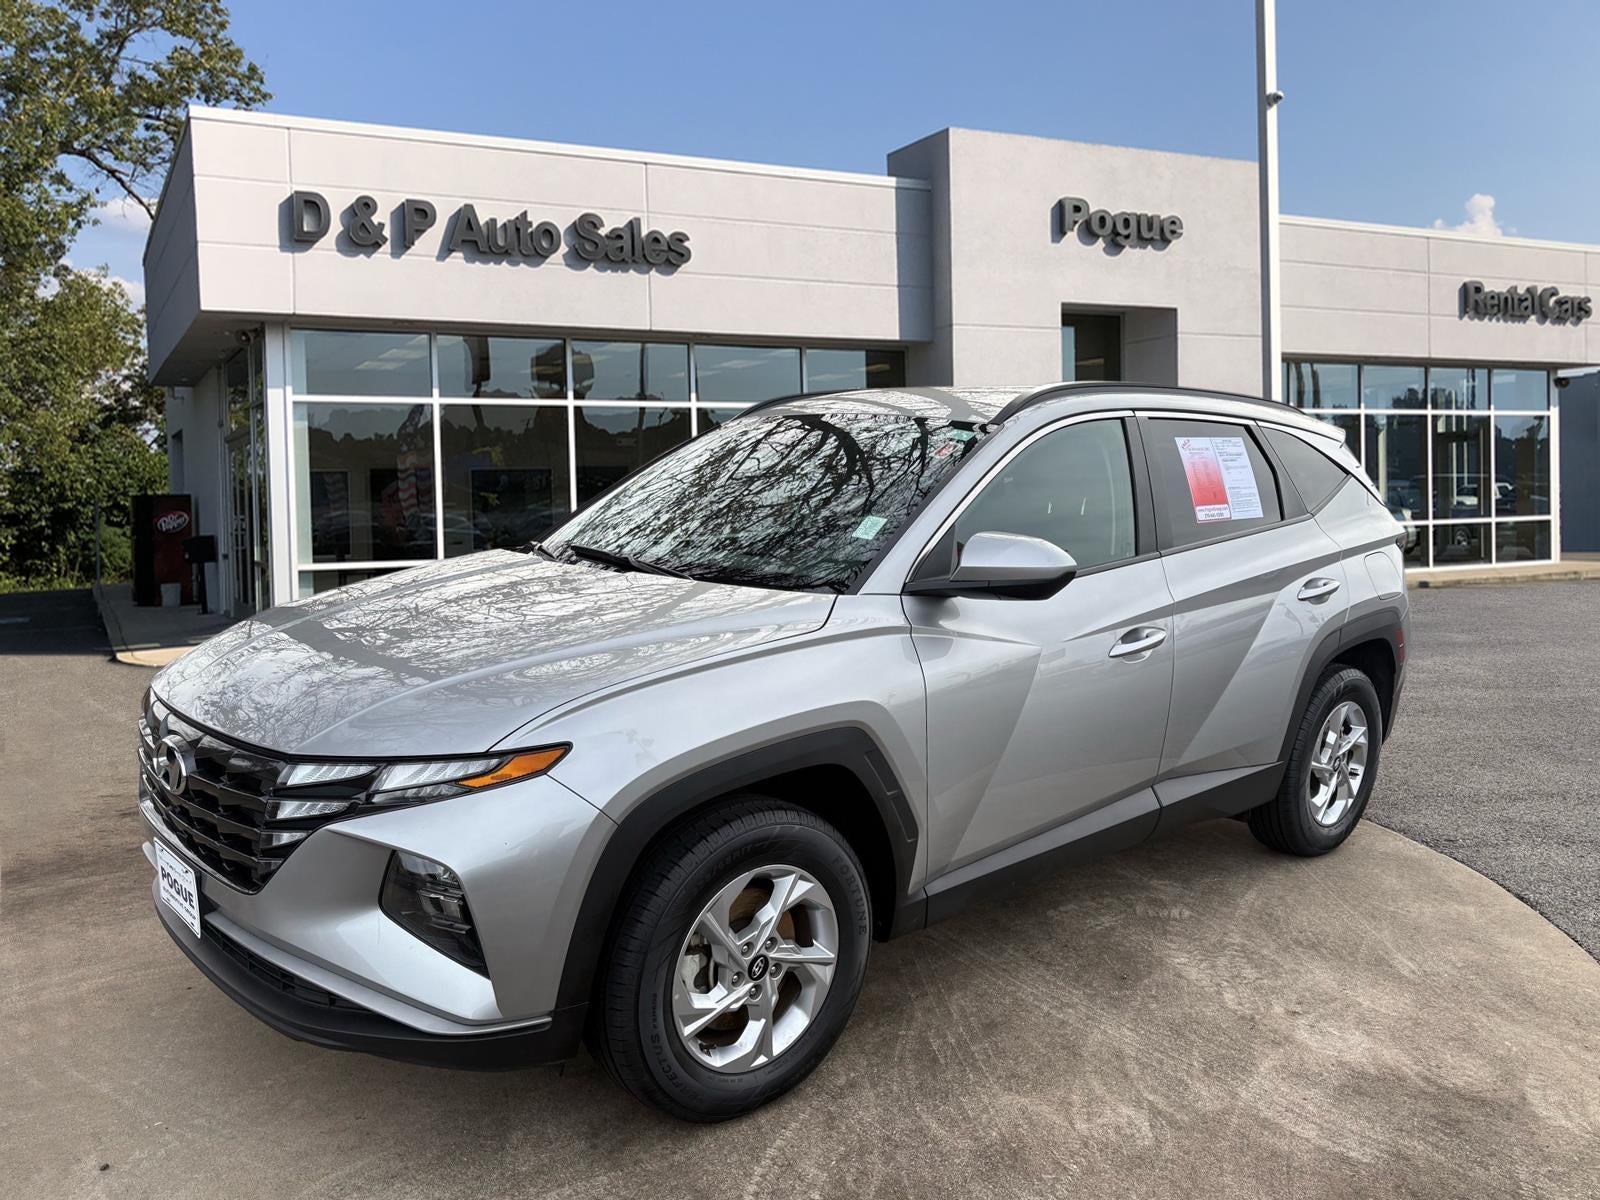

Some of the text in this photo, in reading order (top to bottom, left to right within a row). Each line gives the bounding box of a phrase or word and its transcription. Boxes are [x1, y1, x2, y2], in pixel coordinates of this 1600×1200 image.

[290, 190, 692, 267] D & P Auto Sales
[1058, 197, 1184, 247] Pogue
[1462, 280, 1592, 322] Rental Cars
[161, 865, 195, 910] POGUE
[832, 856, 867, 936] FORTUNE
